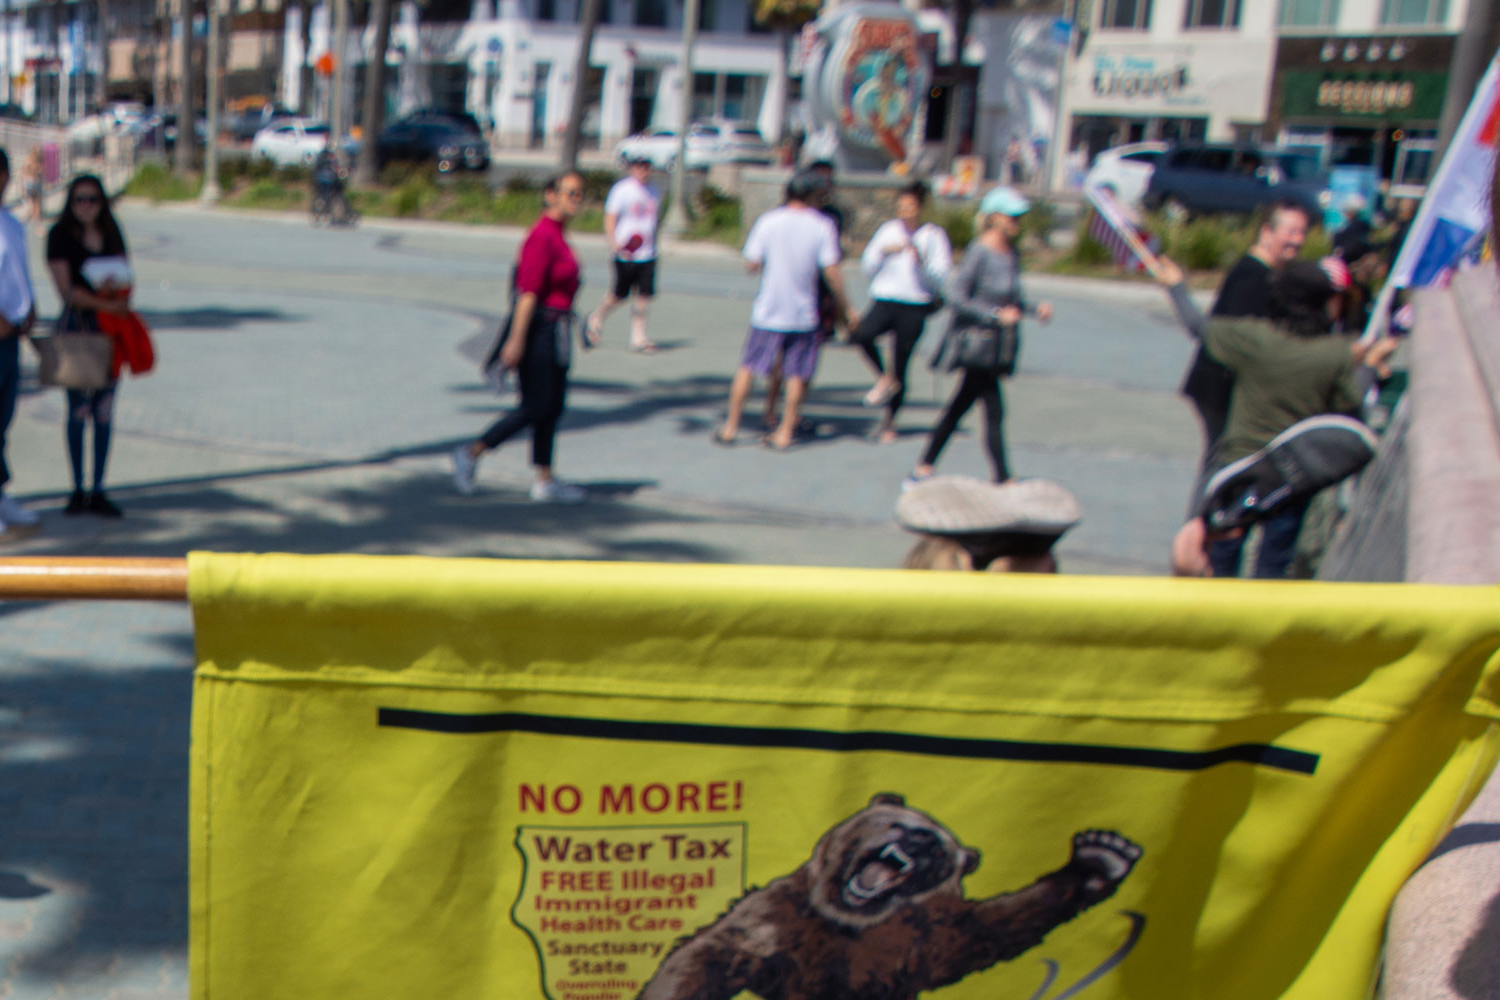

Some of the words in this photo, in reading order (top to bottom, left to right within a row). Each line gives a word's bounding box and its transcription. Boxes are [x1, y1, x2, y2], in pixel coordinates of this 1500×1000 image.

[518, 782, 583, 815] NO
[599, 780, 744, 815] MORE!
[533, 834, 654, 863] Water
[660, 833, 732, 861] Tax
[540, 870, 613, 892] FREE
[621, 866, 715, 894] Illegal
[533, 893, 698, 915] Immigrant
[539, 915, 621, 933] Health
[627, 914, 685, 932] Care
[546, 939, 663, 958] Sanctuary
[568, 959, 627, 976] State
